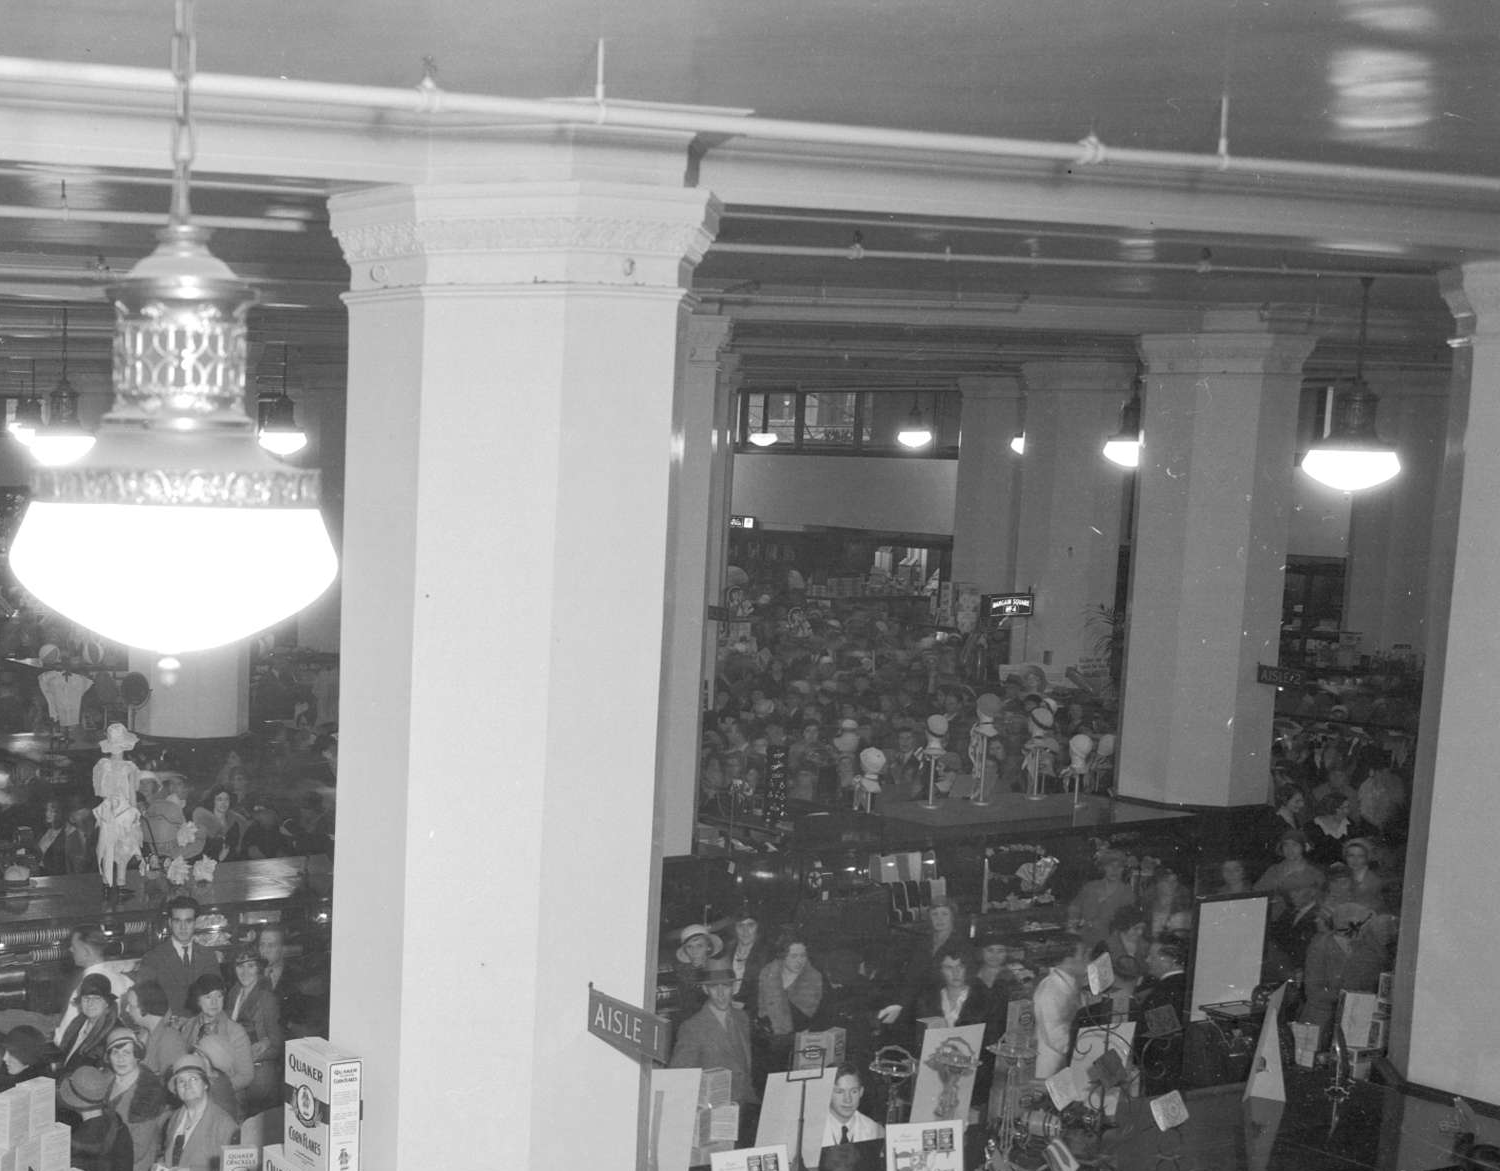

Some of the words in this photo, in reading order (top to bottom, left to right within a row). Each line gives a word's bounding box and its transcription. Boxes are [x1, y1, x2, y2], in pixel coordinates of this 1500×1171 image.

[594, 1003, 642, 1043] AISLE
[289, 1053, 323, 1083] QUAKER
[289, 1125, 303, 1144] CORN
[303, 1133, 321, 1156] FLAKES
